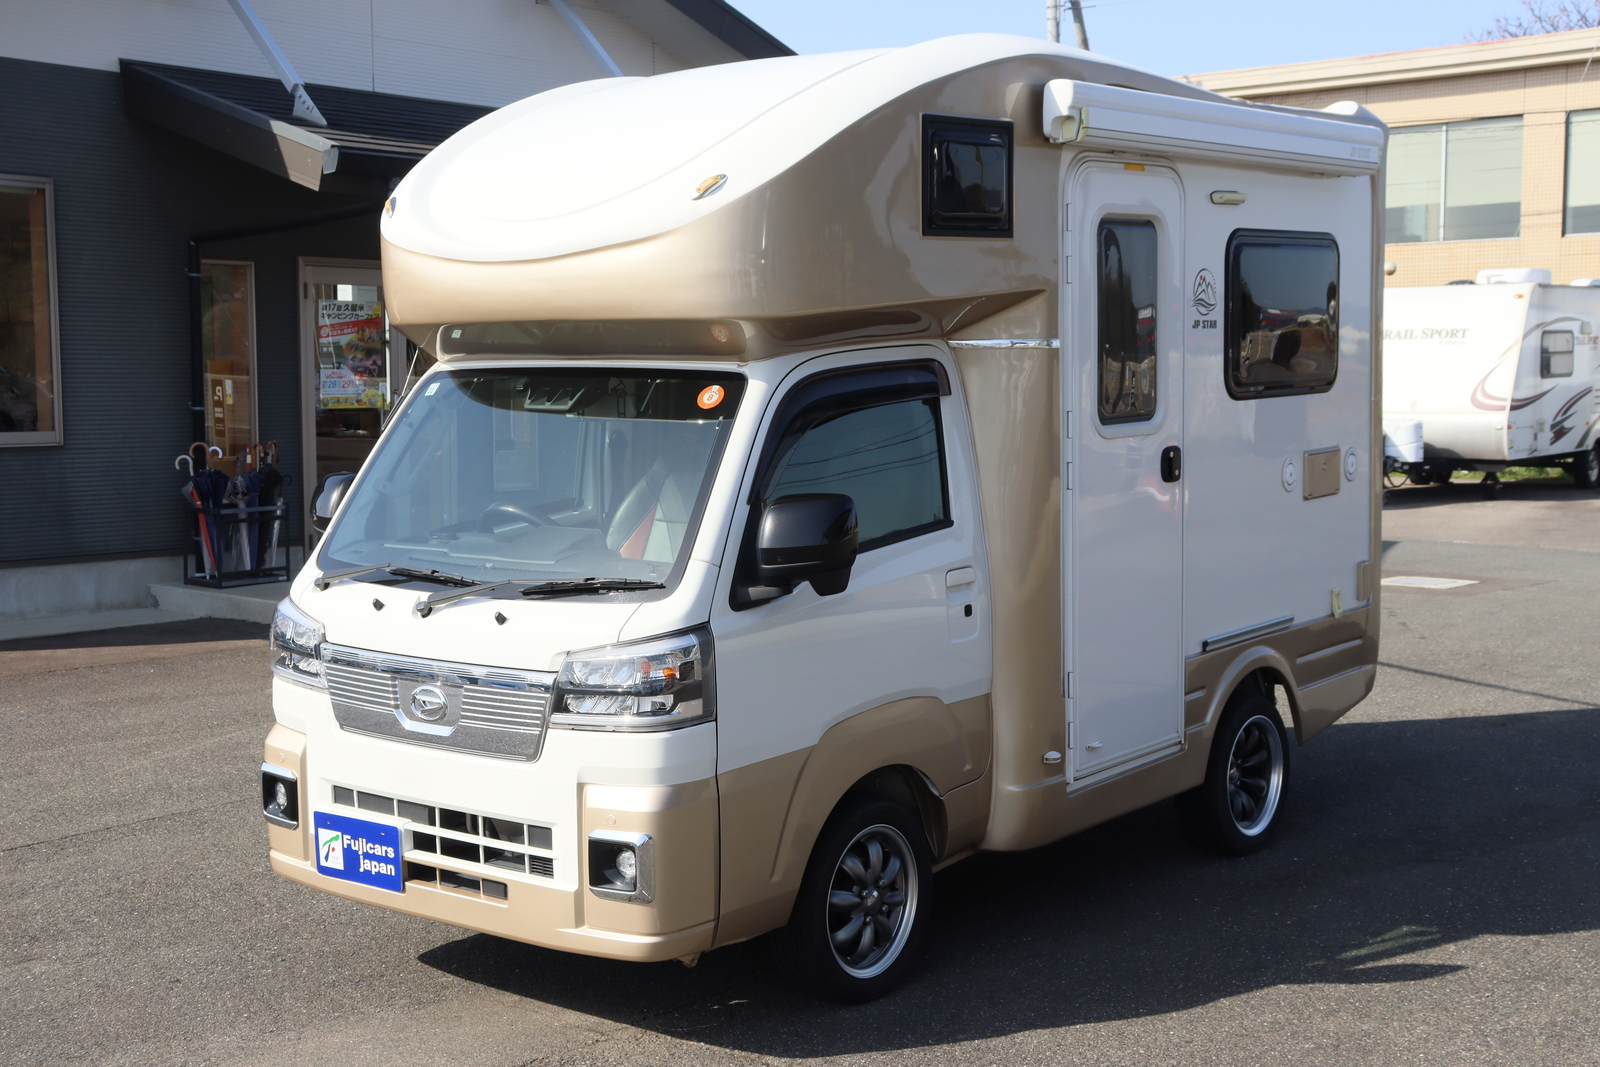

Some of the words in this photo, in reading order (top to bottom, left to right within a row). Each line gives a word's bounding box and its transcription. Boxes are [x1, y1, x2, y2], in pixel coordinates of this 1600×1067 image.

[1192, 319, 1200, 329] JP
[1202, 319, 1217, 329] STAR
[1383, 329, 1418, 340] RAIL
[1420, 328, 1470, 340] SPORT
[343, 834, 395, 858] Fujicars
[359, 855, 395, 876] japan
